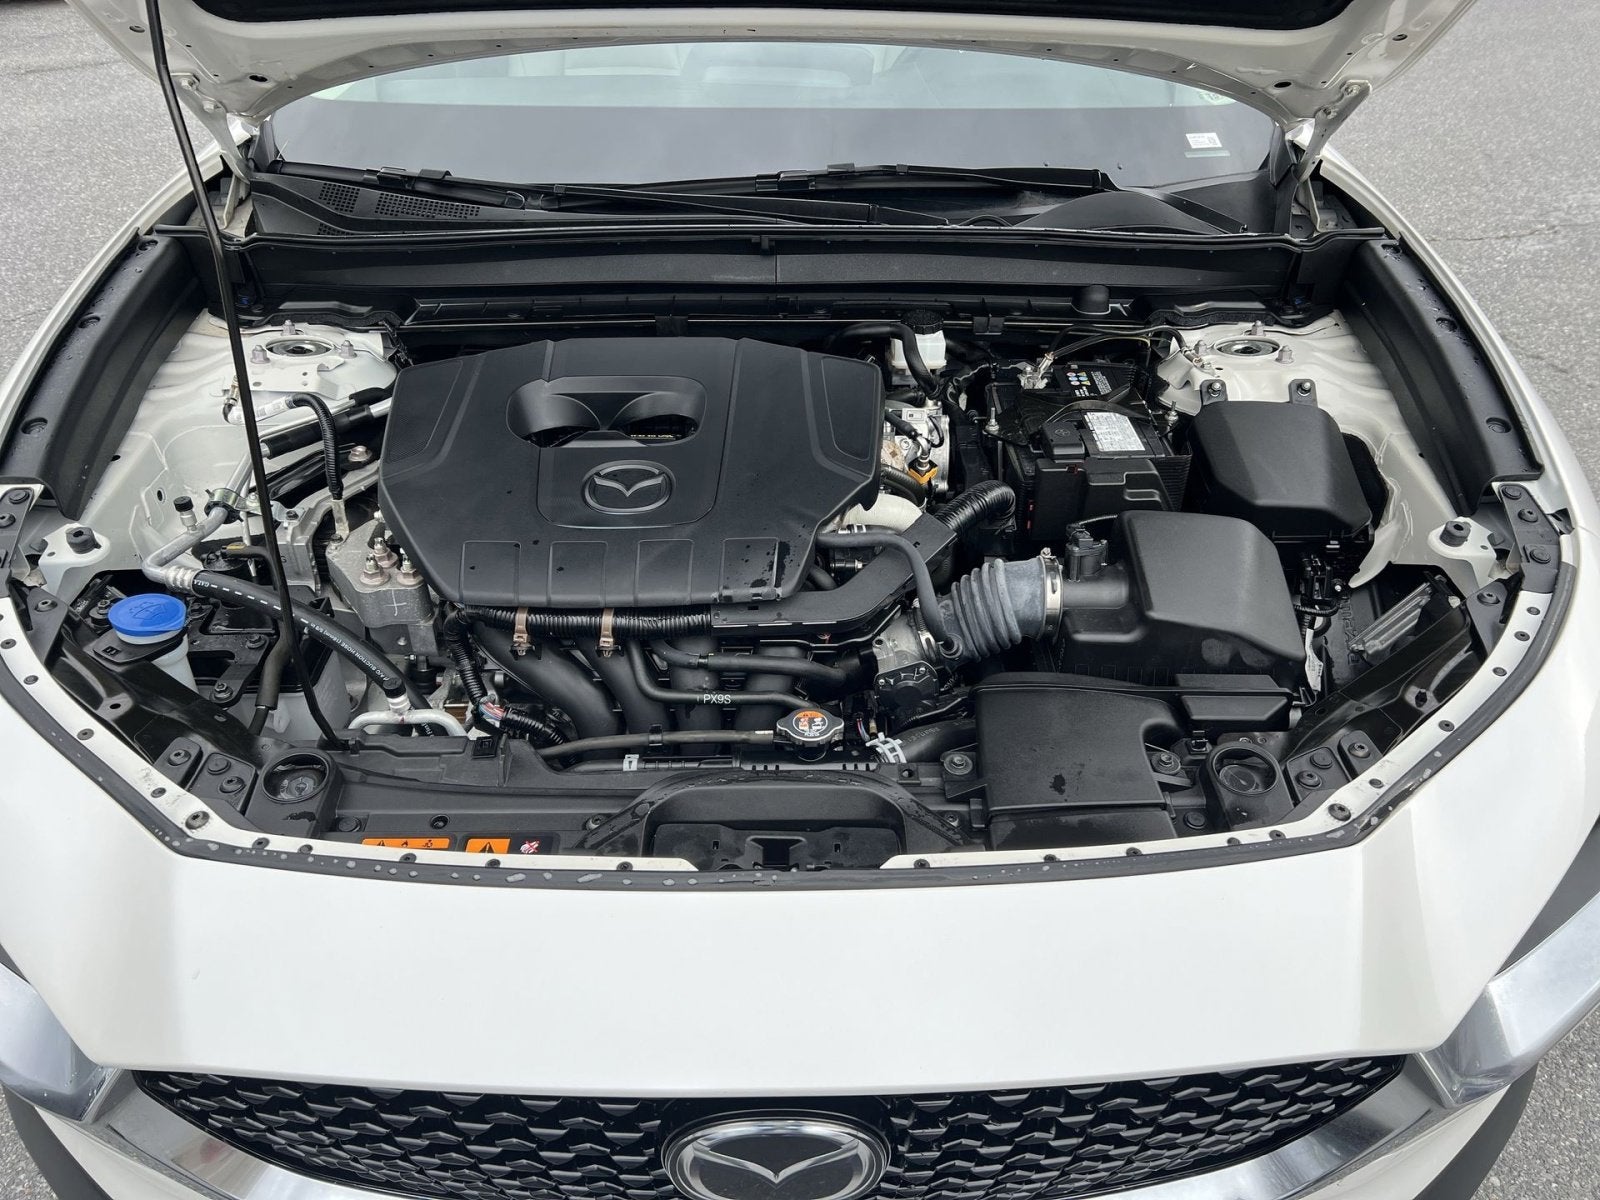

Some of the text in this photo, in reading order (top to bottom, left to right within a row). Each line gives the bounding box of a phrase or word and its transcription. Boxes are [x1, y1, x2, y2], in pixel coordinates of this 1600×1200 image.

[341, 642, 356, 655] HOSE
[355, 652, 377, 671] SUCTION
[703, 693, 732, 705] PX9S
